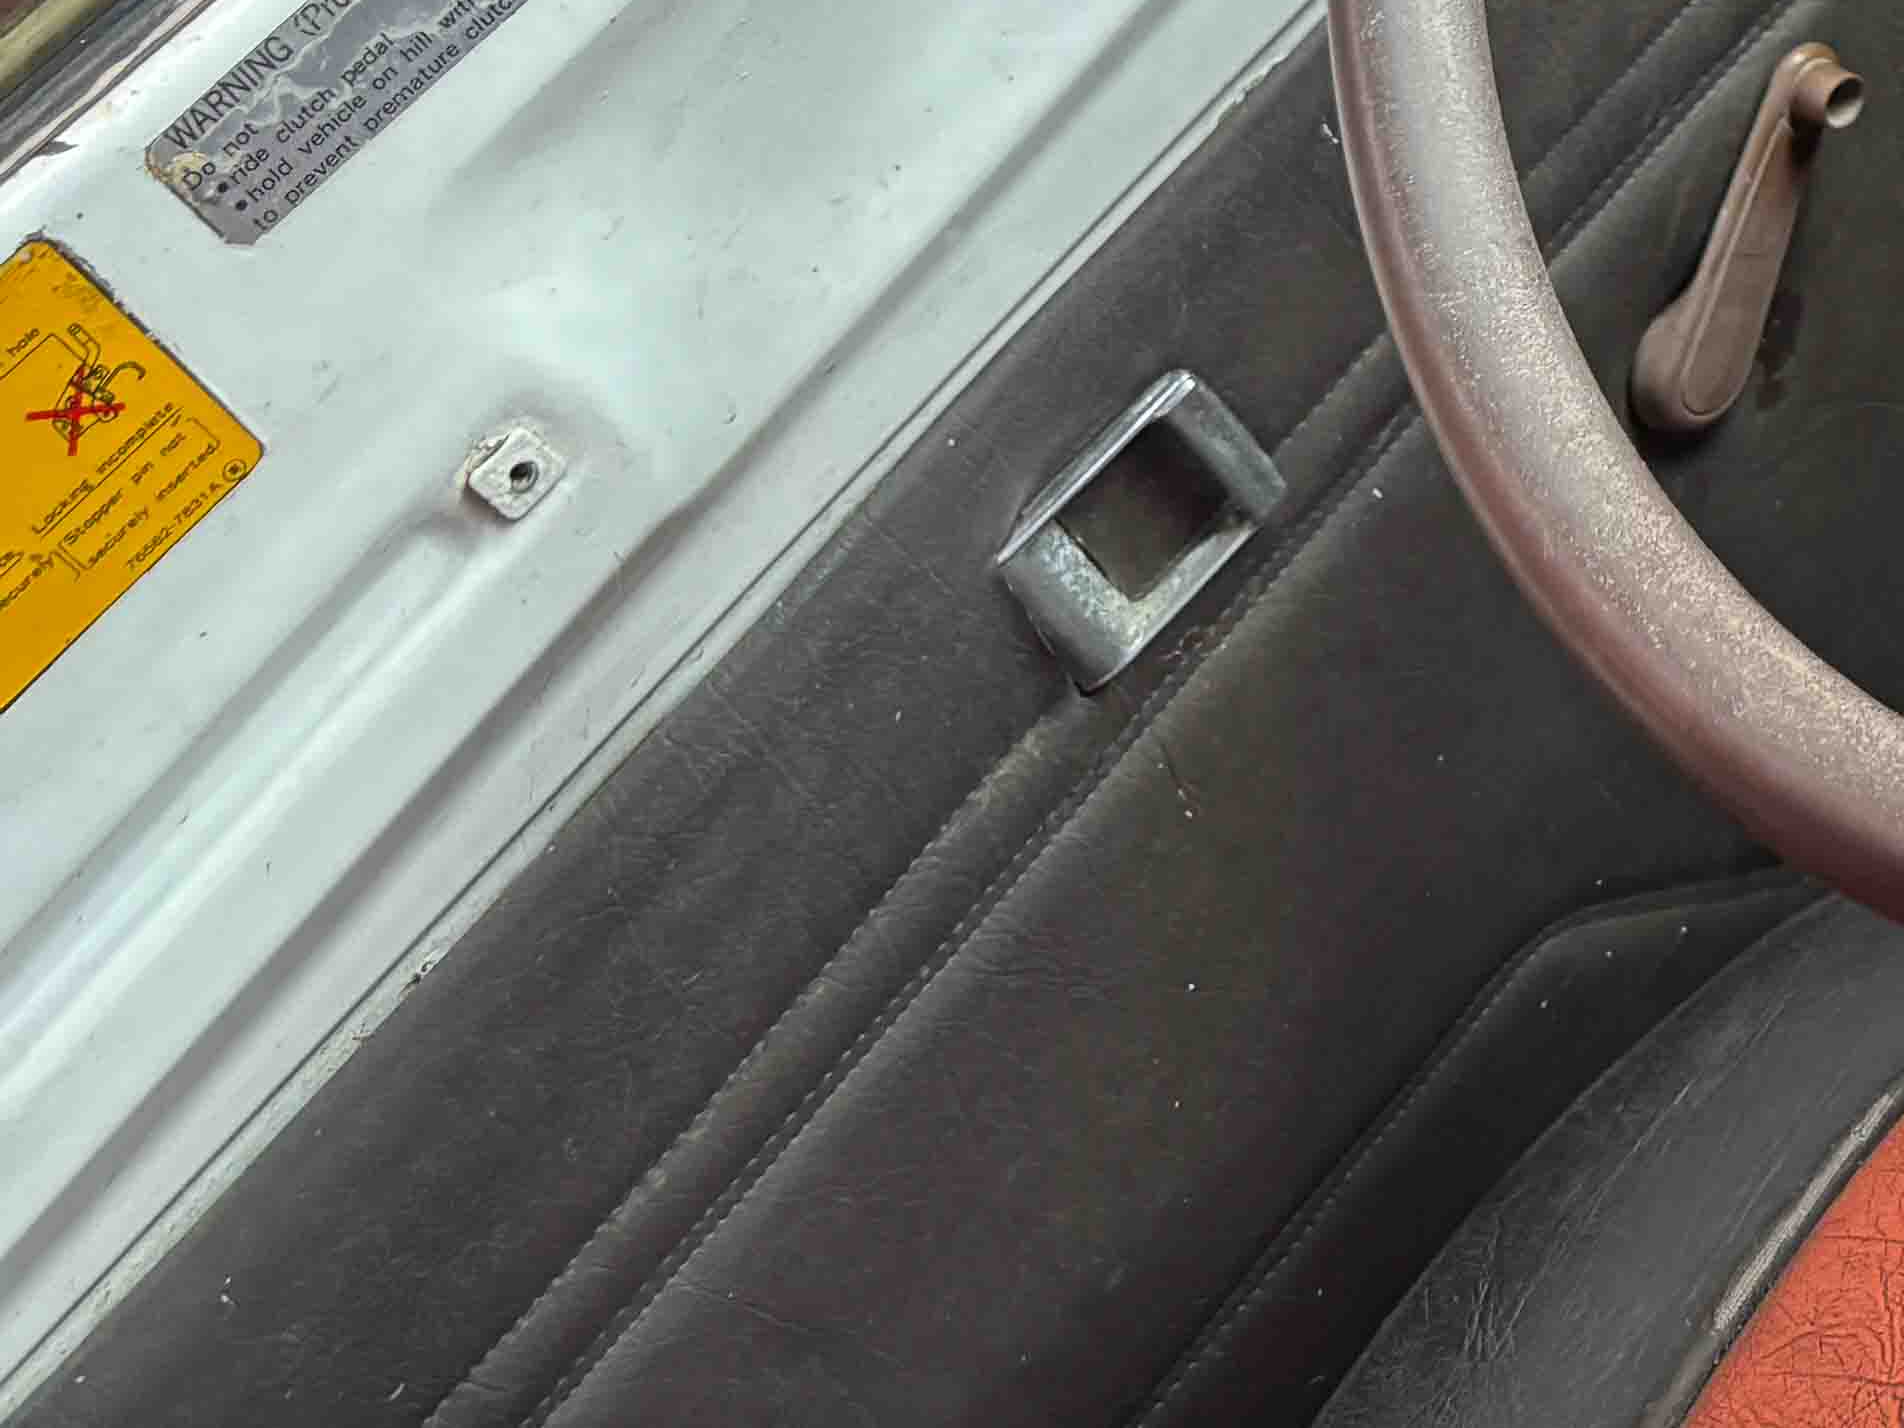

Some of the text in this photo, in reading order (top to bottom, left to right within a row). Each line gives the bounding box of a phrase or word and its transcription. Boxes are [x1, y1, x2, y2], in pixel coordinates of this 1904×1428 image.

[168, 34, 294, 150] WARNING
[228, 30, 396, 184] ride clutch pedal
[247, 157, 294, 203] hold
[297, 94, 368, 156] vehicle
[372, 63, 399, 91] on
[402, 30, 433, 63] hill
[254, 207, 279, 232] to
[284, 133, 360, 206] prevent
[363, 42, 461, 133] premature
[182, 121, 260, 191] Do not
[31, 402, 175, 535] Locking incomplete
[63, 432, 188, 546] Stopper pin not
[155, 442, 217, 503] inserted
